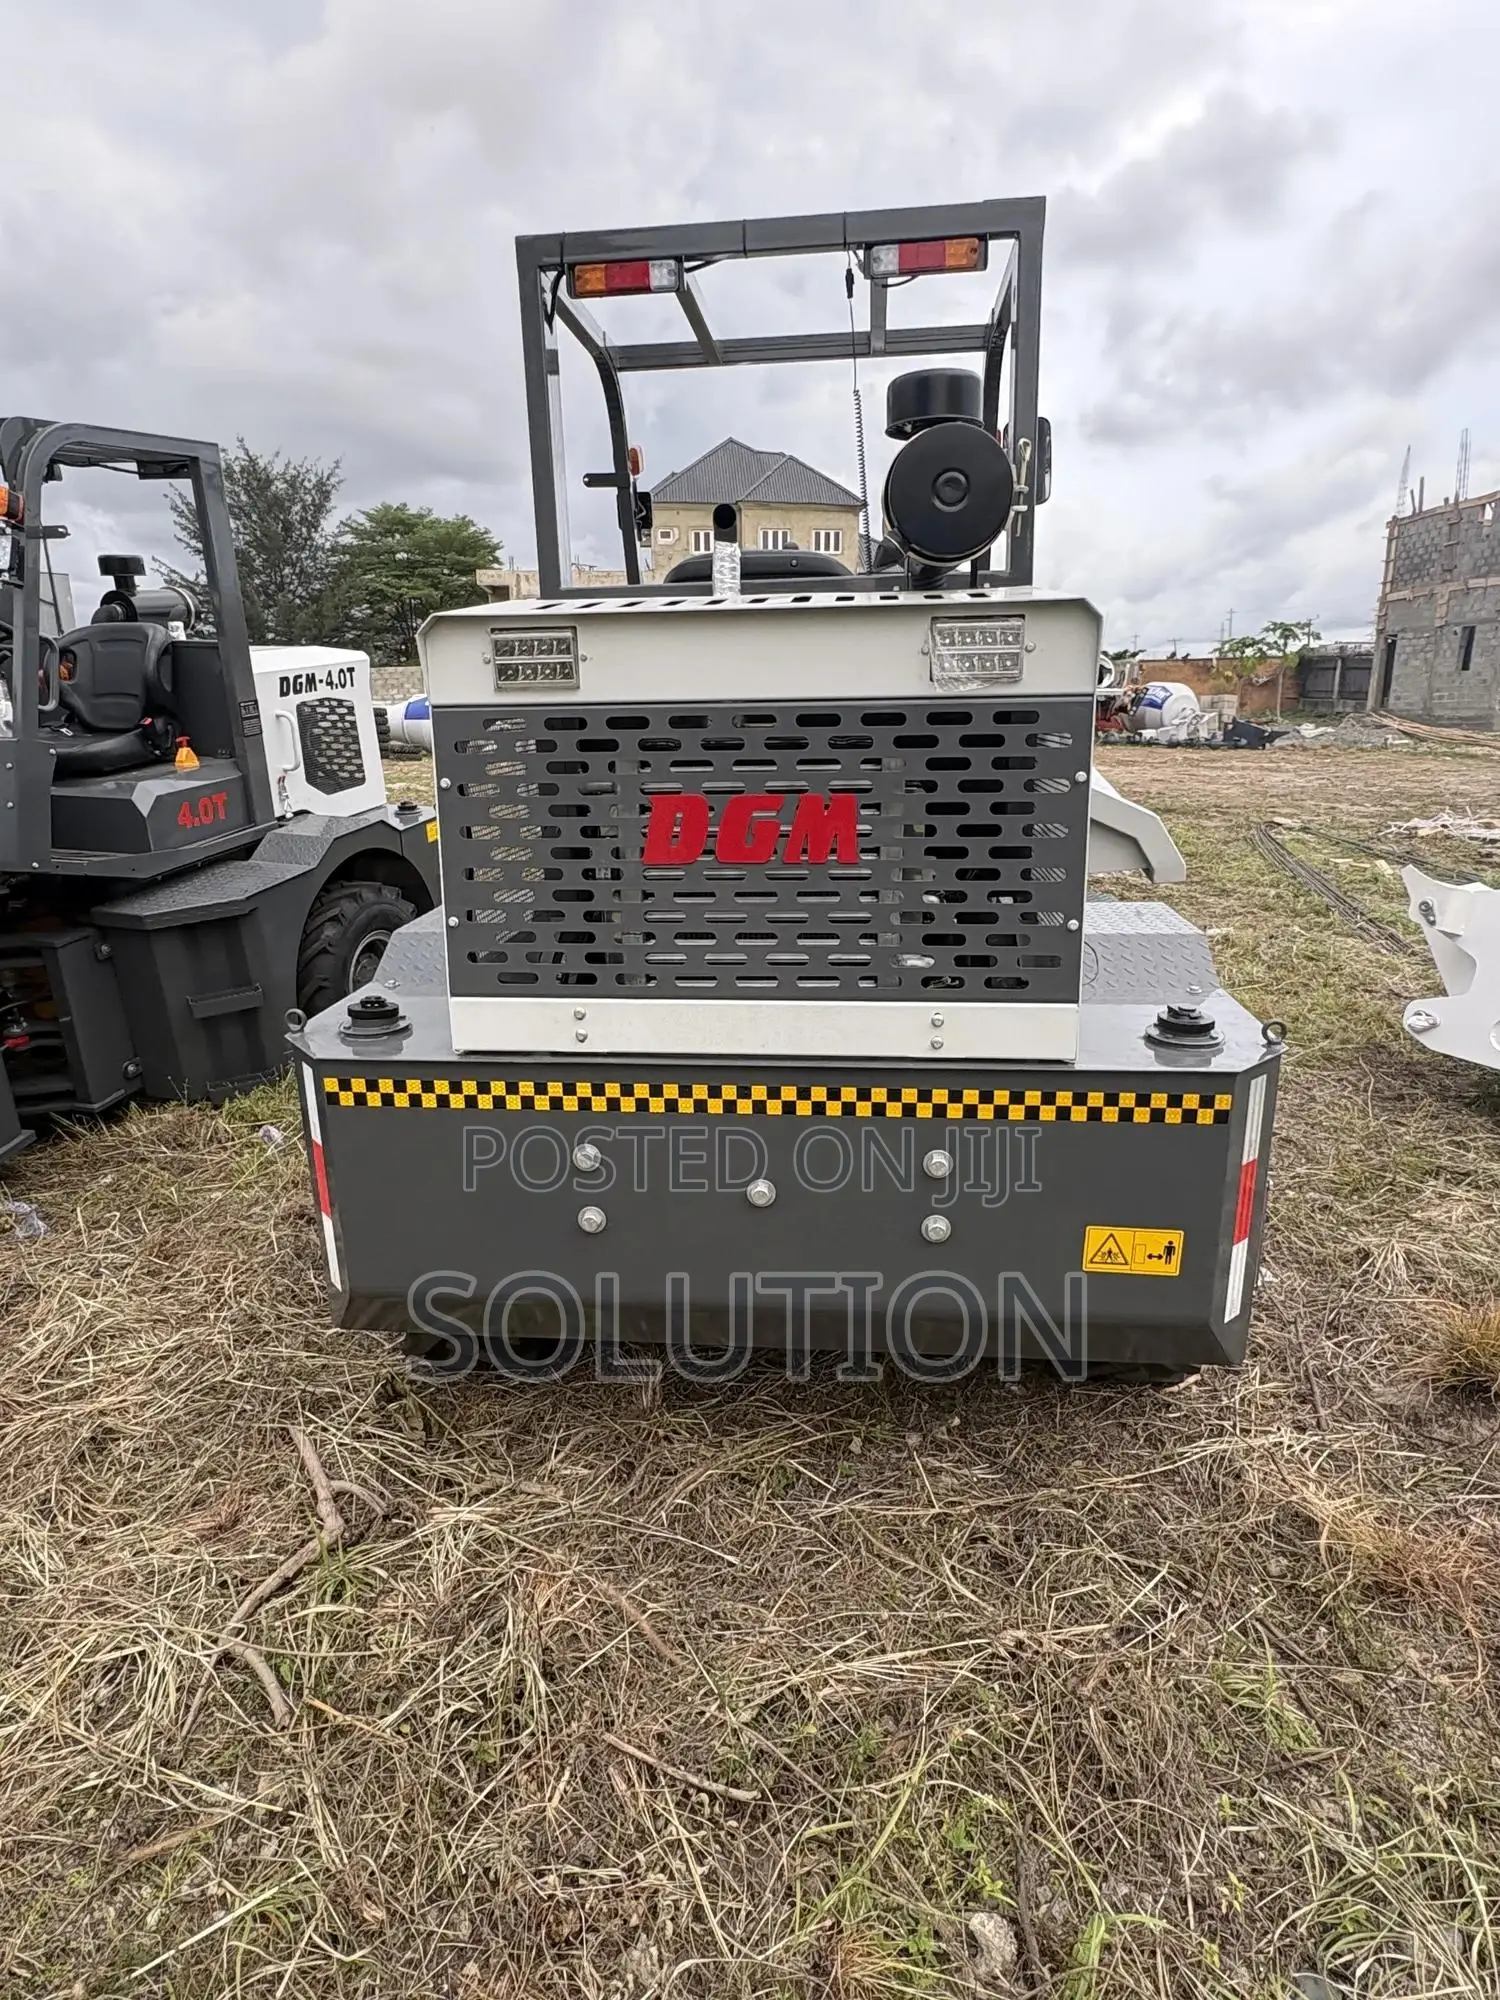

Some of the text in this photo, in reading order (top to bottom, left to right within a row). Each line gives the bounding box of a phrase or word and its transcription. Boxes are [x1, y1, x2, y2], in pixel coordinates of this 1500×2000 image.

[278, 667, 355, 698] DGM-4.0T
[177, 791, 228, 828] 4.0T
[641, 794, 859, 864] DGM
